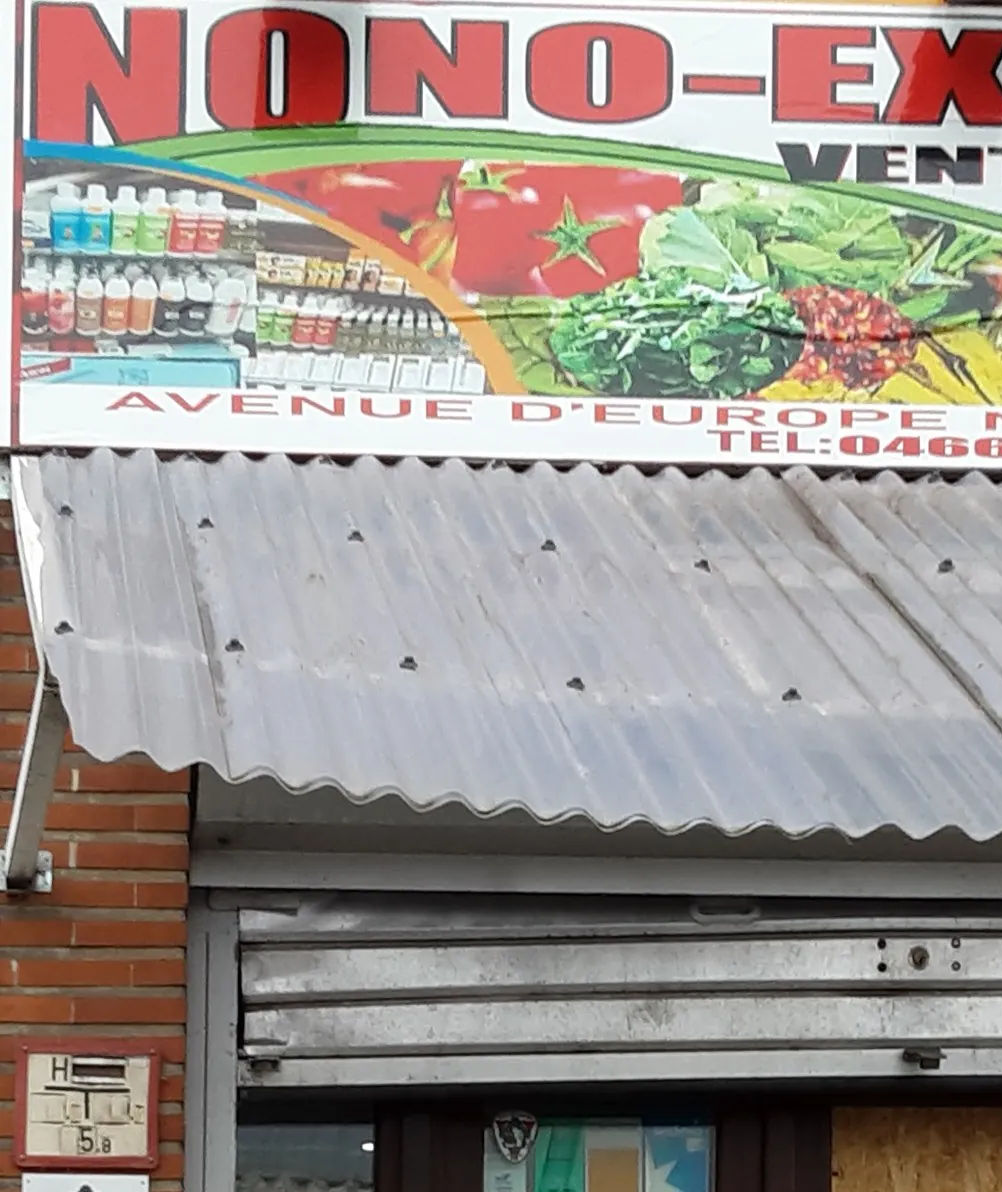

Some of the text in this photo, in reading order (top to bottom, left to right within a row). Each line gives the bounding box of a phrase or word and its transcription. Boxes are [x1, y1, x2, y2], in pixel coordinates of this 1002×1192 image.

[105, 391, 473, 421] AVENUE
[511, 401, 947, 430] D'EUROPE
[51, 1057, 68, 1081] H
